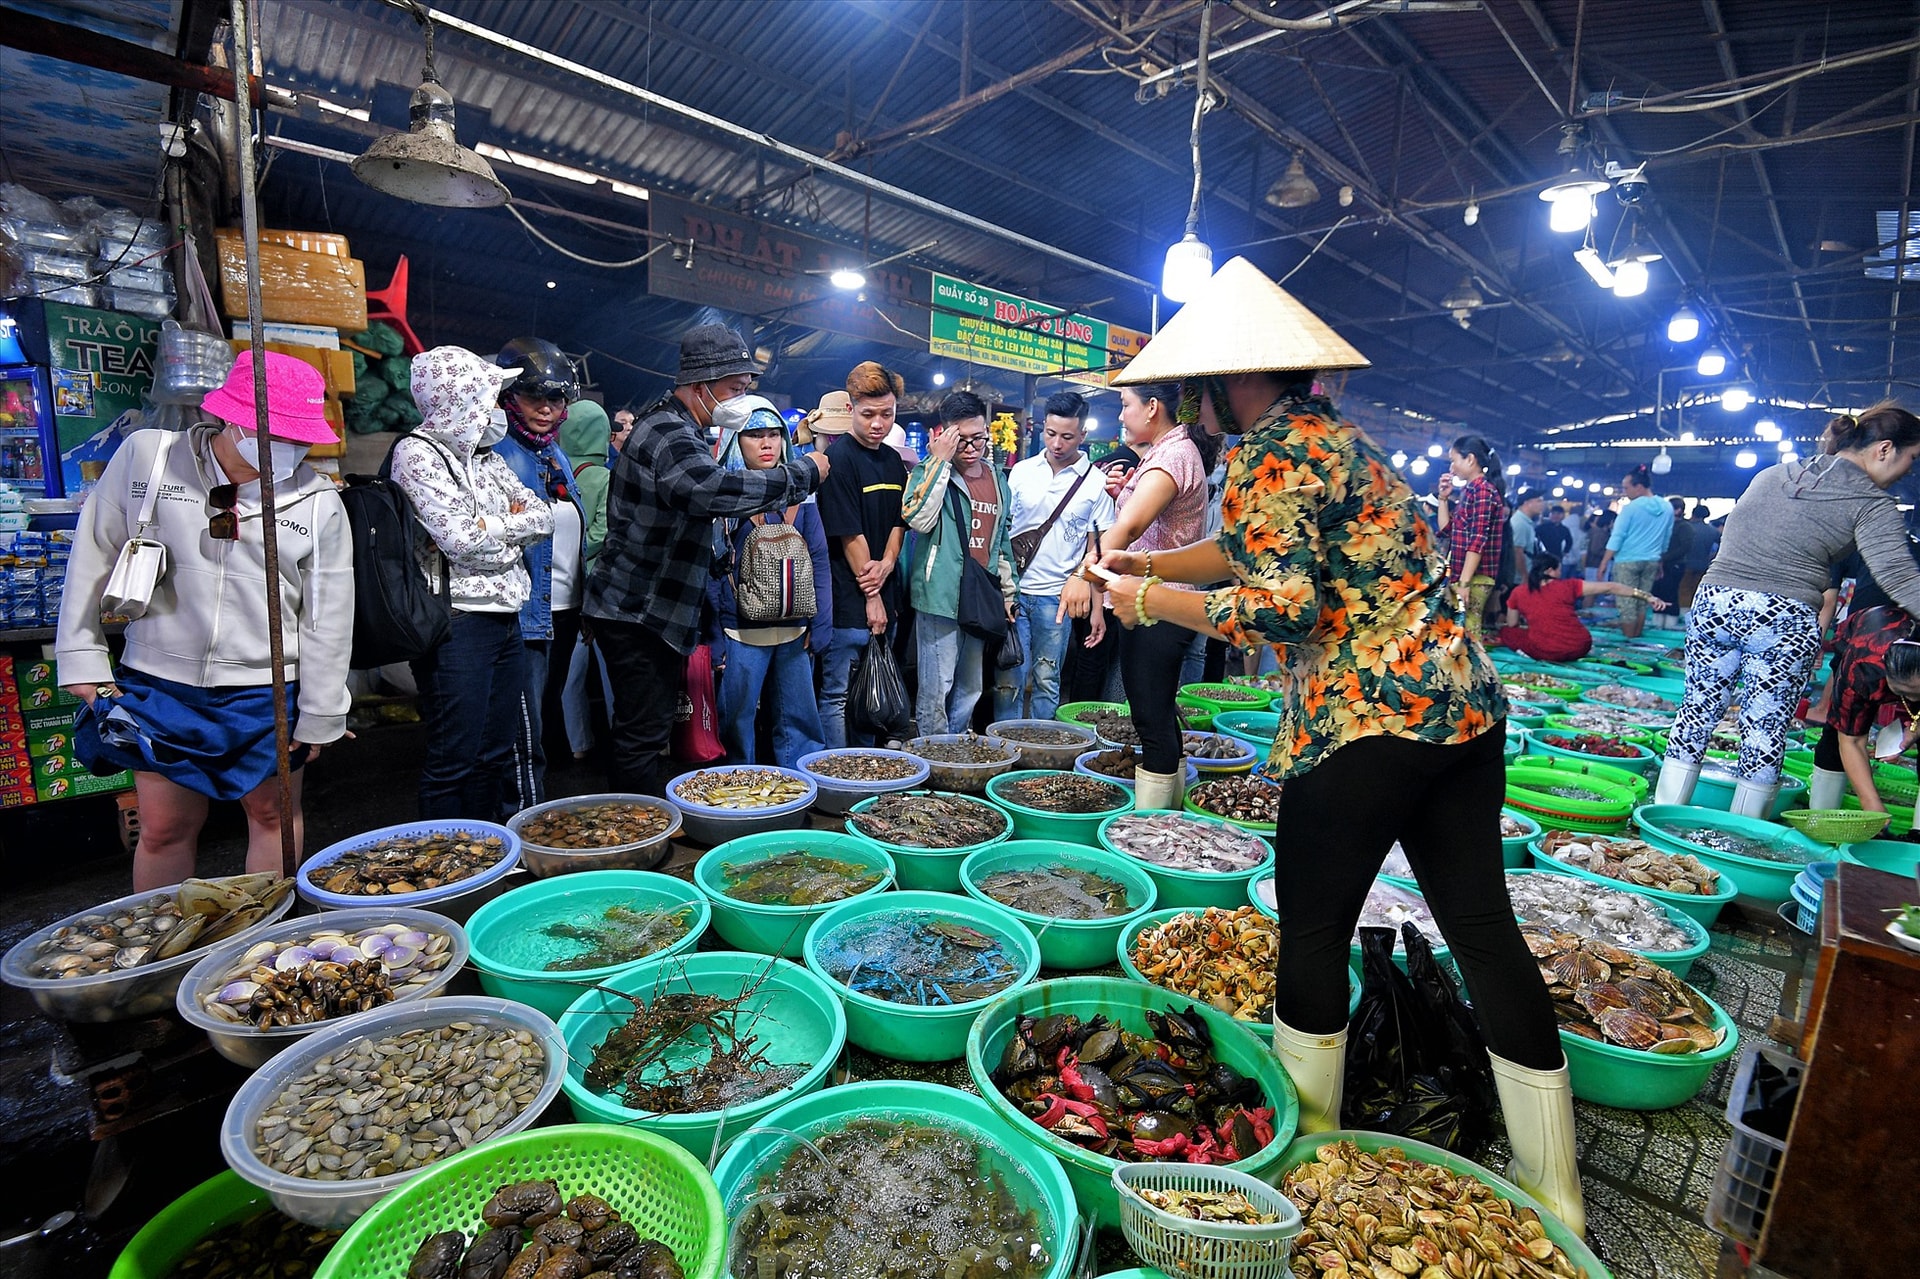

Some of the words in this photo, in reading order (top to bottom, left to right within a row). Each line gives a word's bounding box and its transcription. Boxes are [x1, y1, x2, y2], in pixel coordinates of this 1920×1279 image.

[965, 290, 977, 303] SỐ
[978, 295, 989, 306] 3B
[61, 315, 110, 339] TRÀ
[115, 320, 134, 341] Ô
[995, 300, 1051, 331] HOÀNG
[1055, 316, 1092, 343] LONG
[66, 338, 154, 379] TEA
[132, 481, 186, 492] SIGTURE
[971, 518, 982, 530] O
[968, 536, 985, 548] AY
